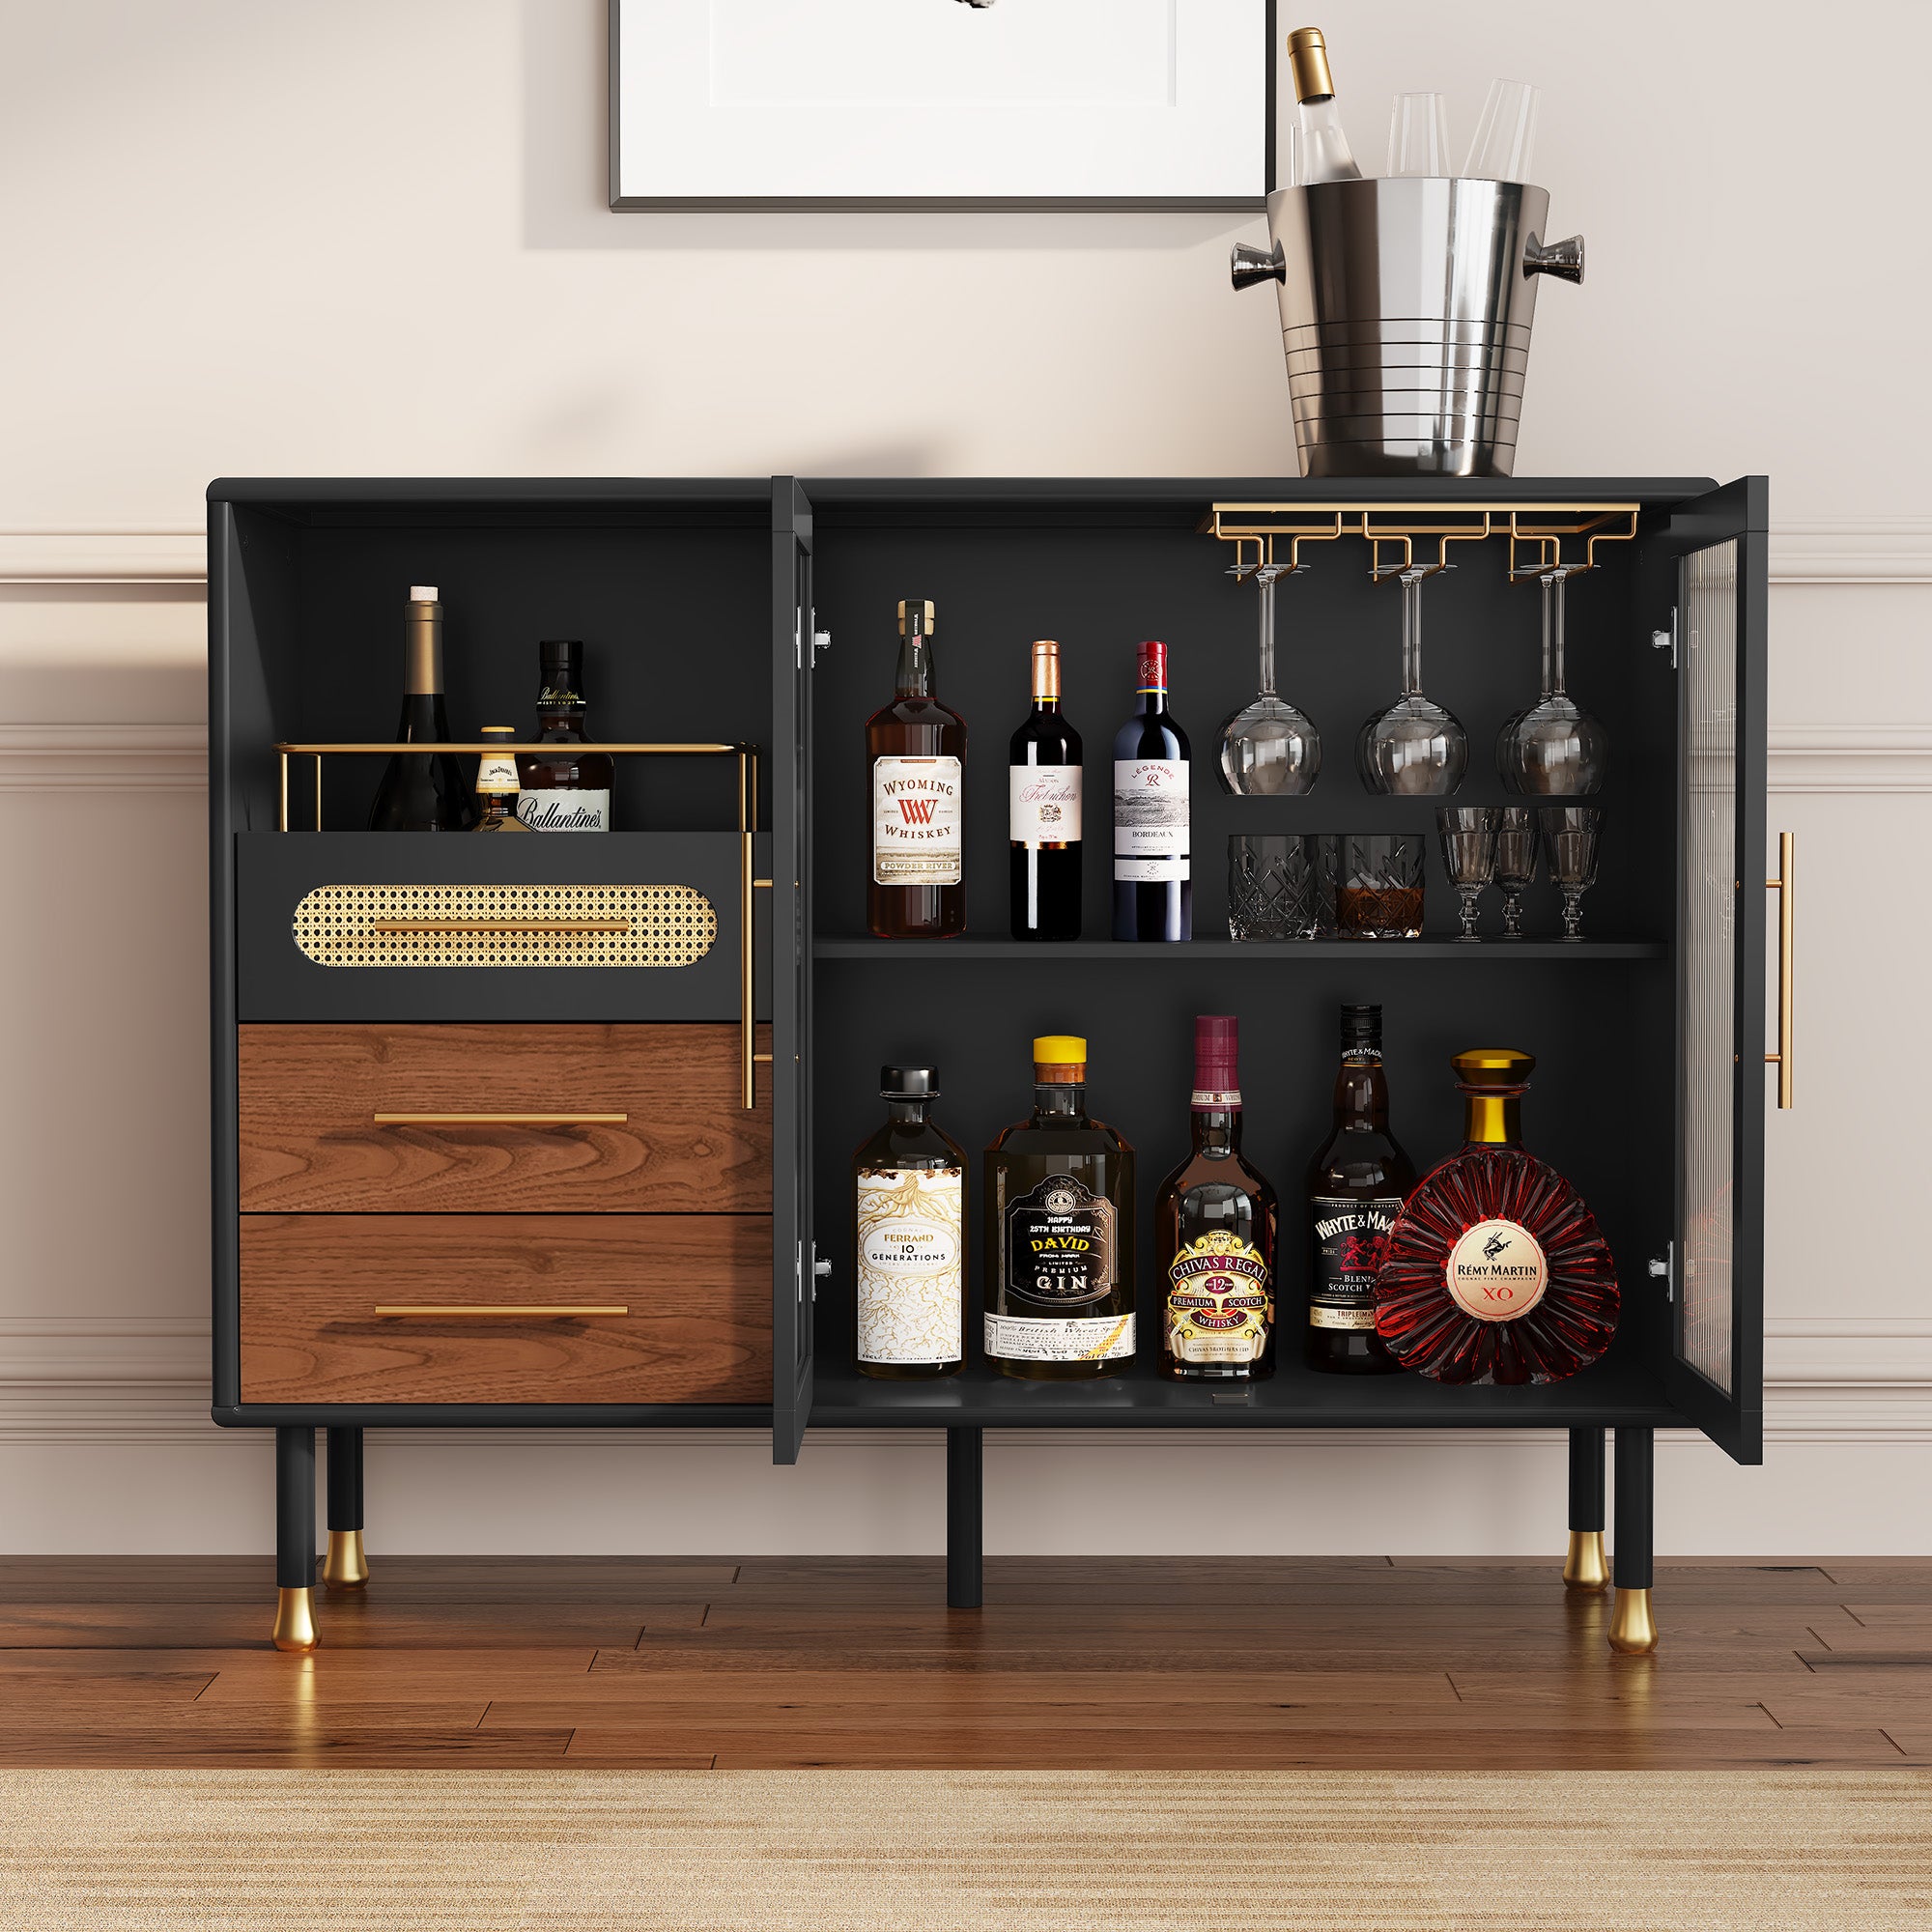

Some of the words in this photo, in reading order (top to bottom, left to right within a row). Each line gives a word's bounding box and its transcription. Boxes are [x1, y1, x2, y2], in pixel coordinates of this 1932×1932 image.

[1131, 764, 1175, 780] LÉGENDE
[883, 779, 953, 796] WYOMING
[518, 797, 602, 829] Ballantine's
[885, 824, 951, 839] WHISKEY
[1315, 1214, 1358, 1240] WHYTE
[1357, 1214, 1366, 1228] &
[884, 1234, 934, 1242] FERRAND
[1030, 1236, 1090, 1252] DAVID
[901, 1244, 915, 1254] 10
[871, 1253, 946, 1262] GENERATIONS
[1034, 1265, 1088, 1274] PREMIUM
[1173, 1257, 1219, 1280] CHIVAS
[1225, 1257, 1264, 1282] REGAL
[1458, 1264, 1489, 1276] RÉMY
[1491, 1264, 1537, 1276] MARTIN
[1037, 1275, 1088, 1290] GIN
[1211, 1278, 1226, 1291] 12
[1328, 1283, 1363, 1292] SCOTCH
[1481, 1287, 1514, 1301] XO
[1173, 1296, 1213, 1307] PREMIUM
[1228, 1297, 1262, 1307] SCOTCH
[1198, 1316, 1239, 1328] WHISKY
